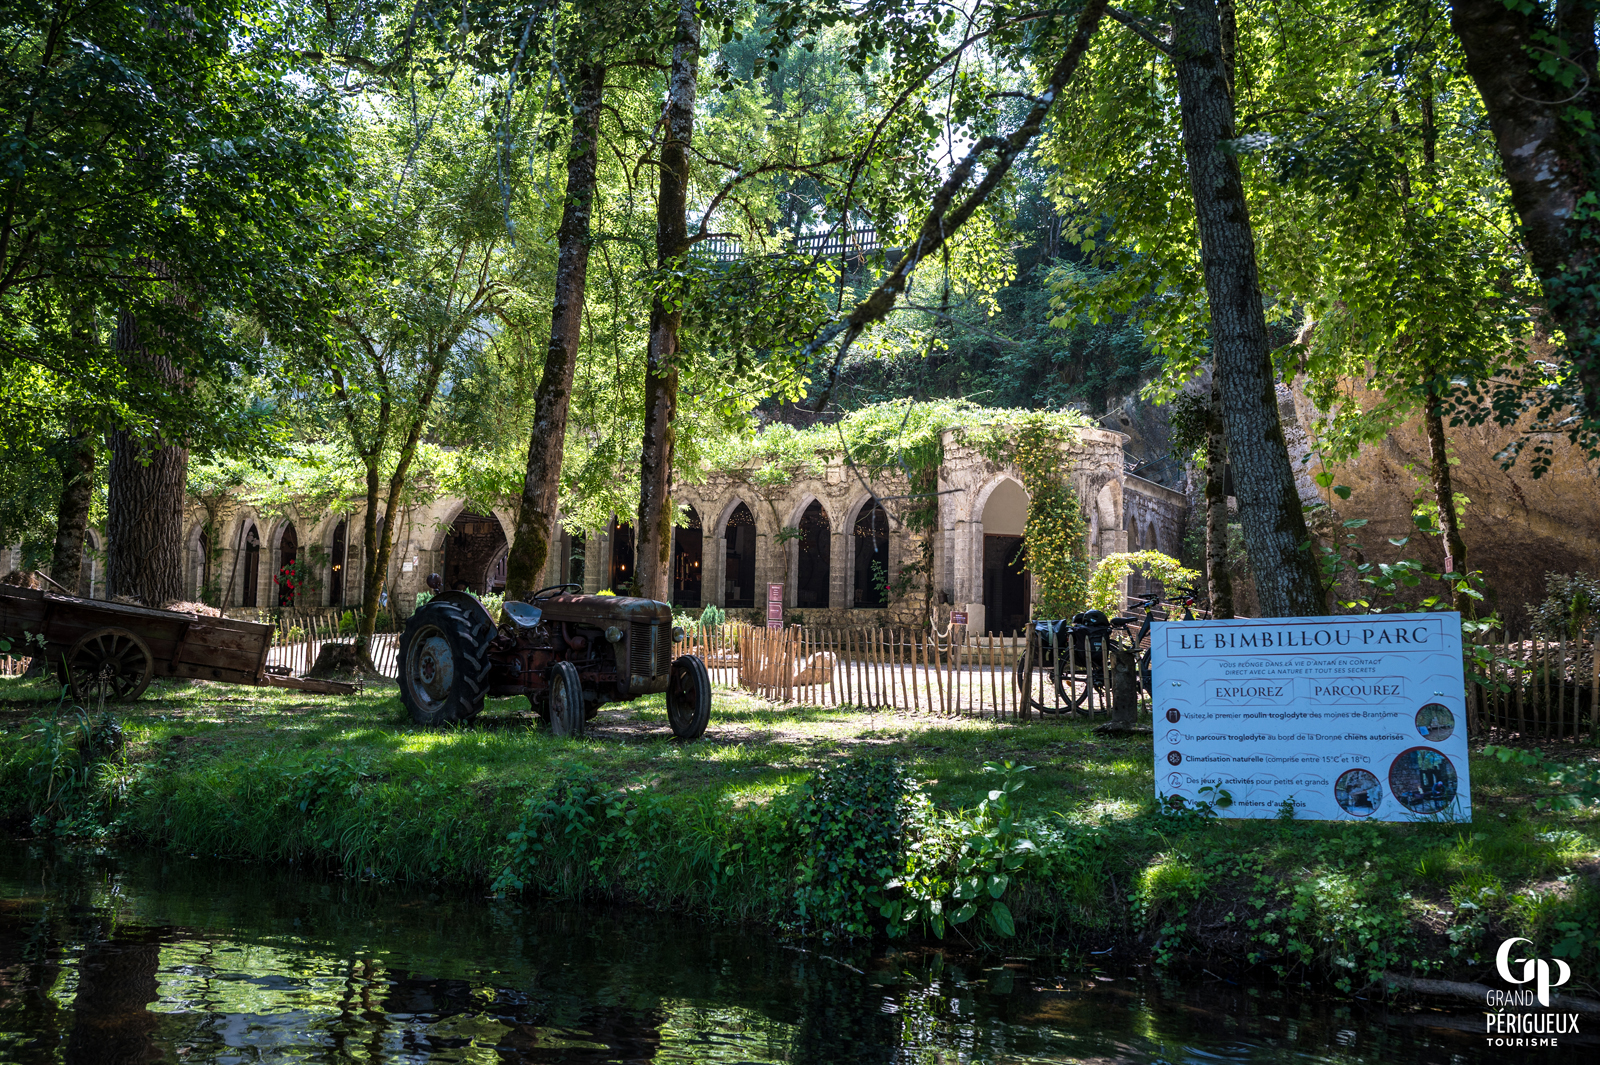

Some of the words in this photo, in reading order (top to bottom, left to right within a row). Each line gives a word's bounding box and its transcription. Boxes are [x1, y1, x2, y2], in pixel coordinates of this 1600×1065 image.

[1180, 634, 1205, 649] LE
[1215, 630, 1351, 649] BIMBILLOU
[1362, 627, 1428, 645] PARC
[1216, 686, 1284, 698] EXPLOREZ
[1314, 684, 1400, 697] PARCOUREZ
[1215, 712, 1241, 721] premier
[1269, 711, 1308, 720] troglodyte
[1362, 710, 1398, 718] Brantôme
[1196, 734, 1226, 742] parcours
[1228, 733, 1266, 742] troglodyte
[1277, 733, 1295, 741] bord
[1315, 733, 1342, 741] Dronne
[1344, 733, 1368, 741] chiens
[1369, 733, 1404, 741] autorisés
[1185, 755, 1231, 763] Climatisation
[1232, 755, 1264, 763] naturelle
[1265, 755, 1299, 764] (comprise
[1322, 755, 1340, 763] 15°C
[1350, 755, 1371, 764] 18°C)
[1200, 777, 1216, 785] jeux
[1224, 777, 1254, 785] activités
[1256, 778, 1272, 786] pour
[1273, 777, 1294, 786] petits
[1304, 778, 1329, 786] grands
[1238, 799, 1265, 807] métiers
[1266, 799, 1307, 808] d'aufois
